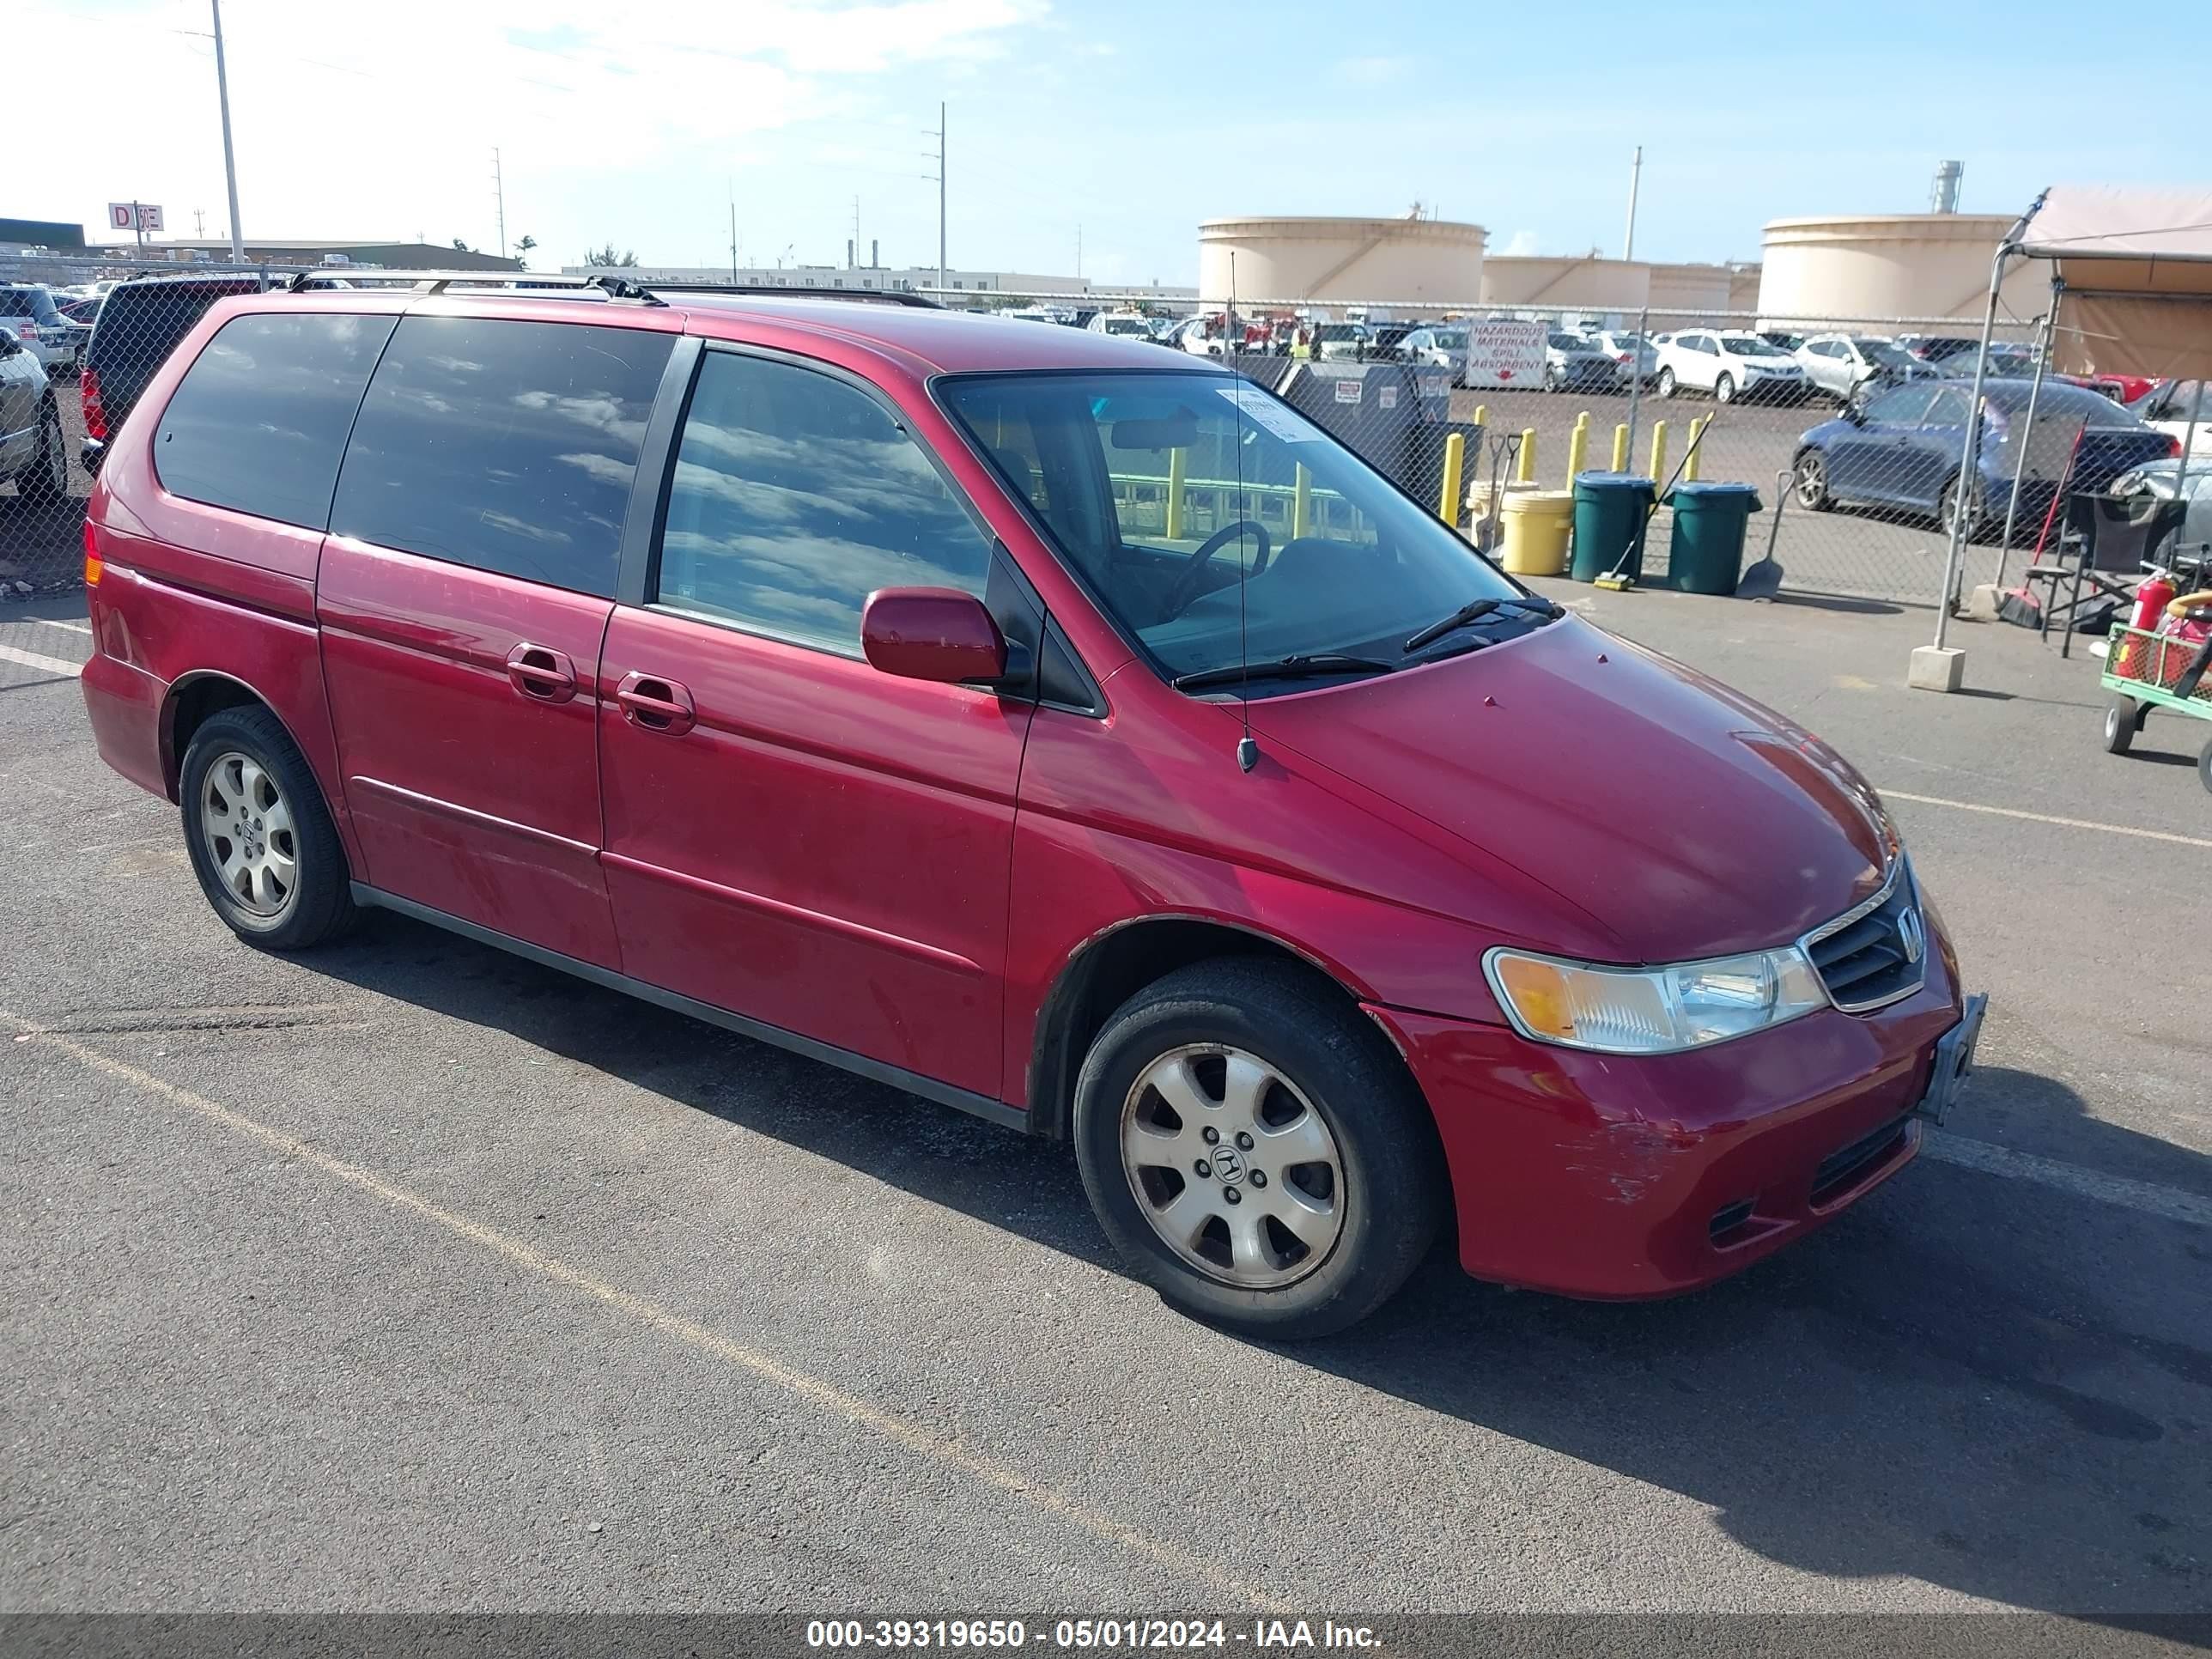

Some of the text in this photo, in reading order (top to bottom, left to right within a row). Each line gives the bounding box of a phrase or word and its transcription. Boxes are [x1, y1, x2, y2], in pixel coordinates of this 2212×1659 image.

[1474, 325, 1545, 337] HAZARDOUS
[1476, 337, 1540, 347] MATERIALS
[1492, 349, 1522, 359] SPILL
[1472, 360, 1540, 371] ABSORBENT
